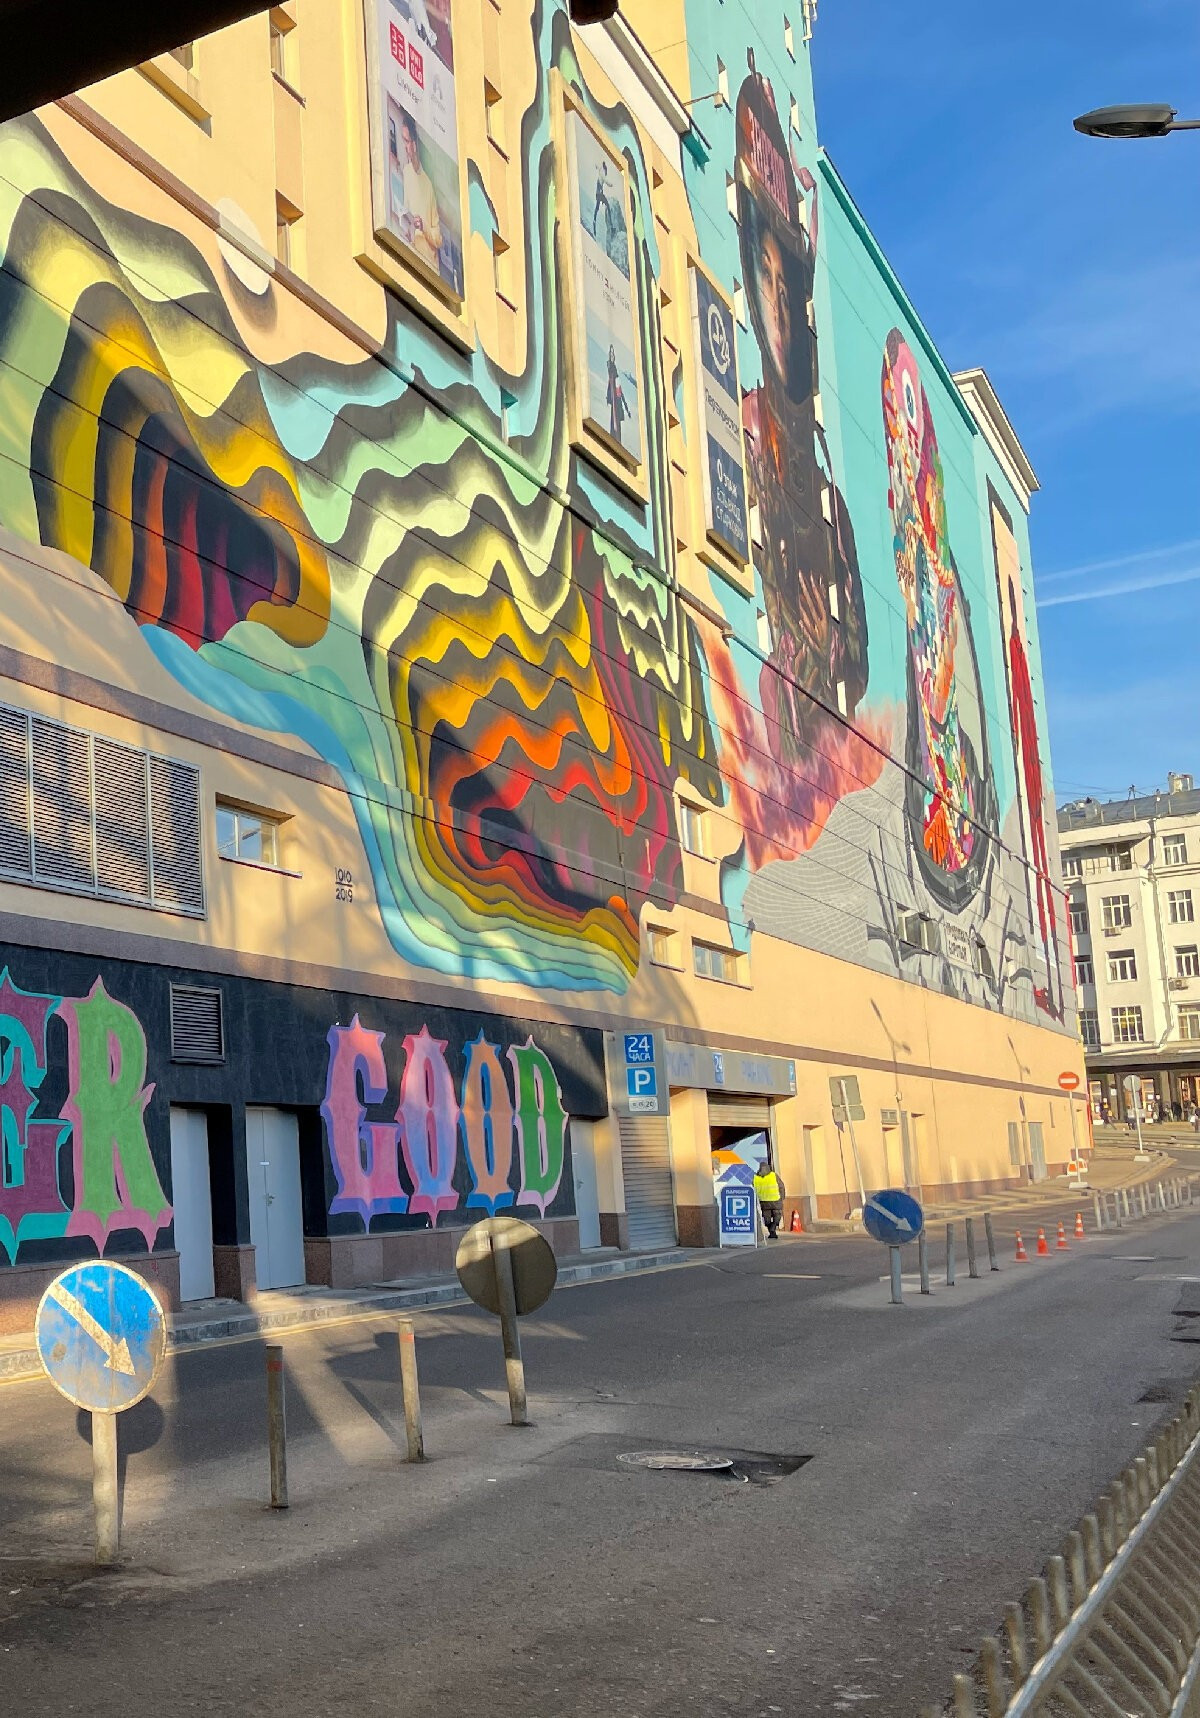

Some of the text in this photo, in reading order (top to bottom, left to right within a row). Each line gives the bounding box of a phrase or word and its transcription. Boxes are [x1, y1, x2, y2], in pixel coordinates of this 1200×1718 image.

[335, 888, 353, 903] 2019
[627, 1036, 650, 1053] 24
[628, 1053, 651, 1062] ЧАСА
[634, 1069, 651, 1094] P
[320, 1012, 569, 1234] GOOD
[732, 1198, 746, 1215] P
